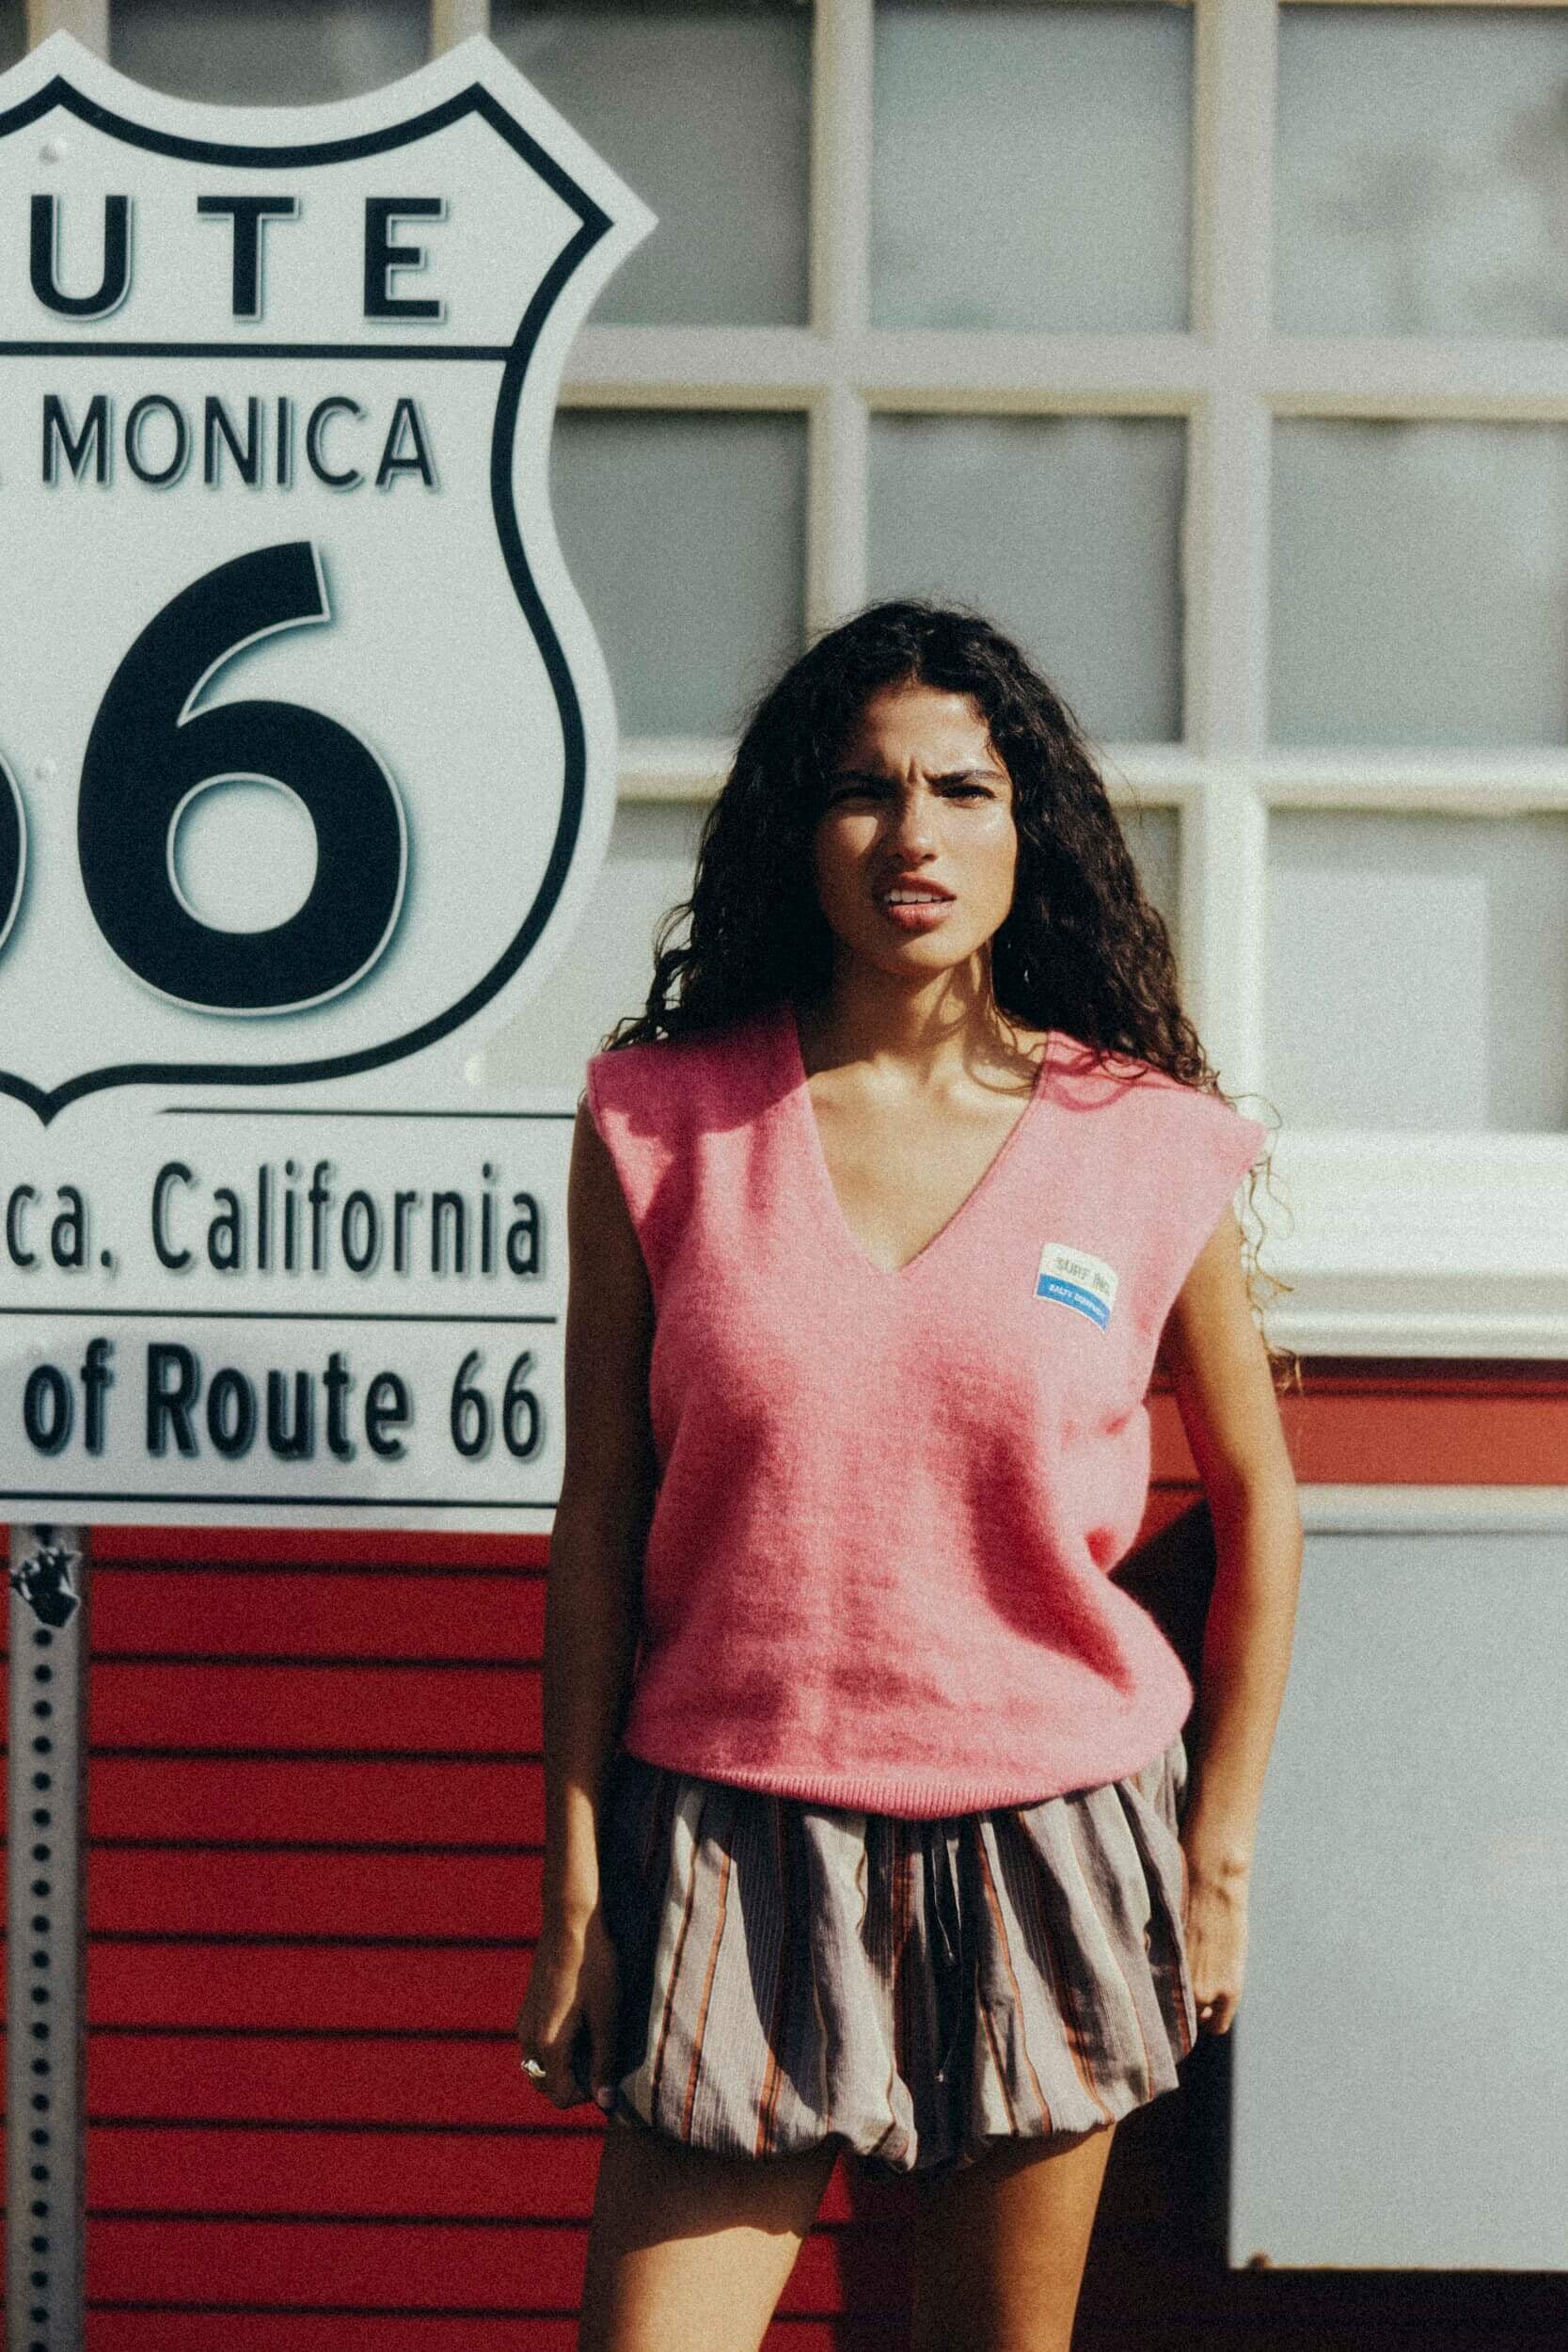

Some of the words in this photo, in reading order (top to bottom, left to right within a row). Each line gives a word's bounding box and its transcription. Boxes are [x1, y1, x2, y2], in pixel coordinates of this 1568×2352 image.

[30, 195, 444, 318] UTE
[43, 394, 434, 486] MONICA
[0, 541, 406, 1011] 6
[152, 1161, 542, 1276] California
[23, 1338, 114, 1457] of
[146, 1343, 411, 1464] Route
[451, 1350, 542, 1459] 66
